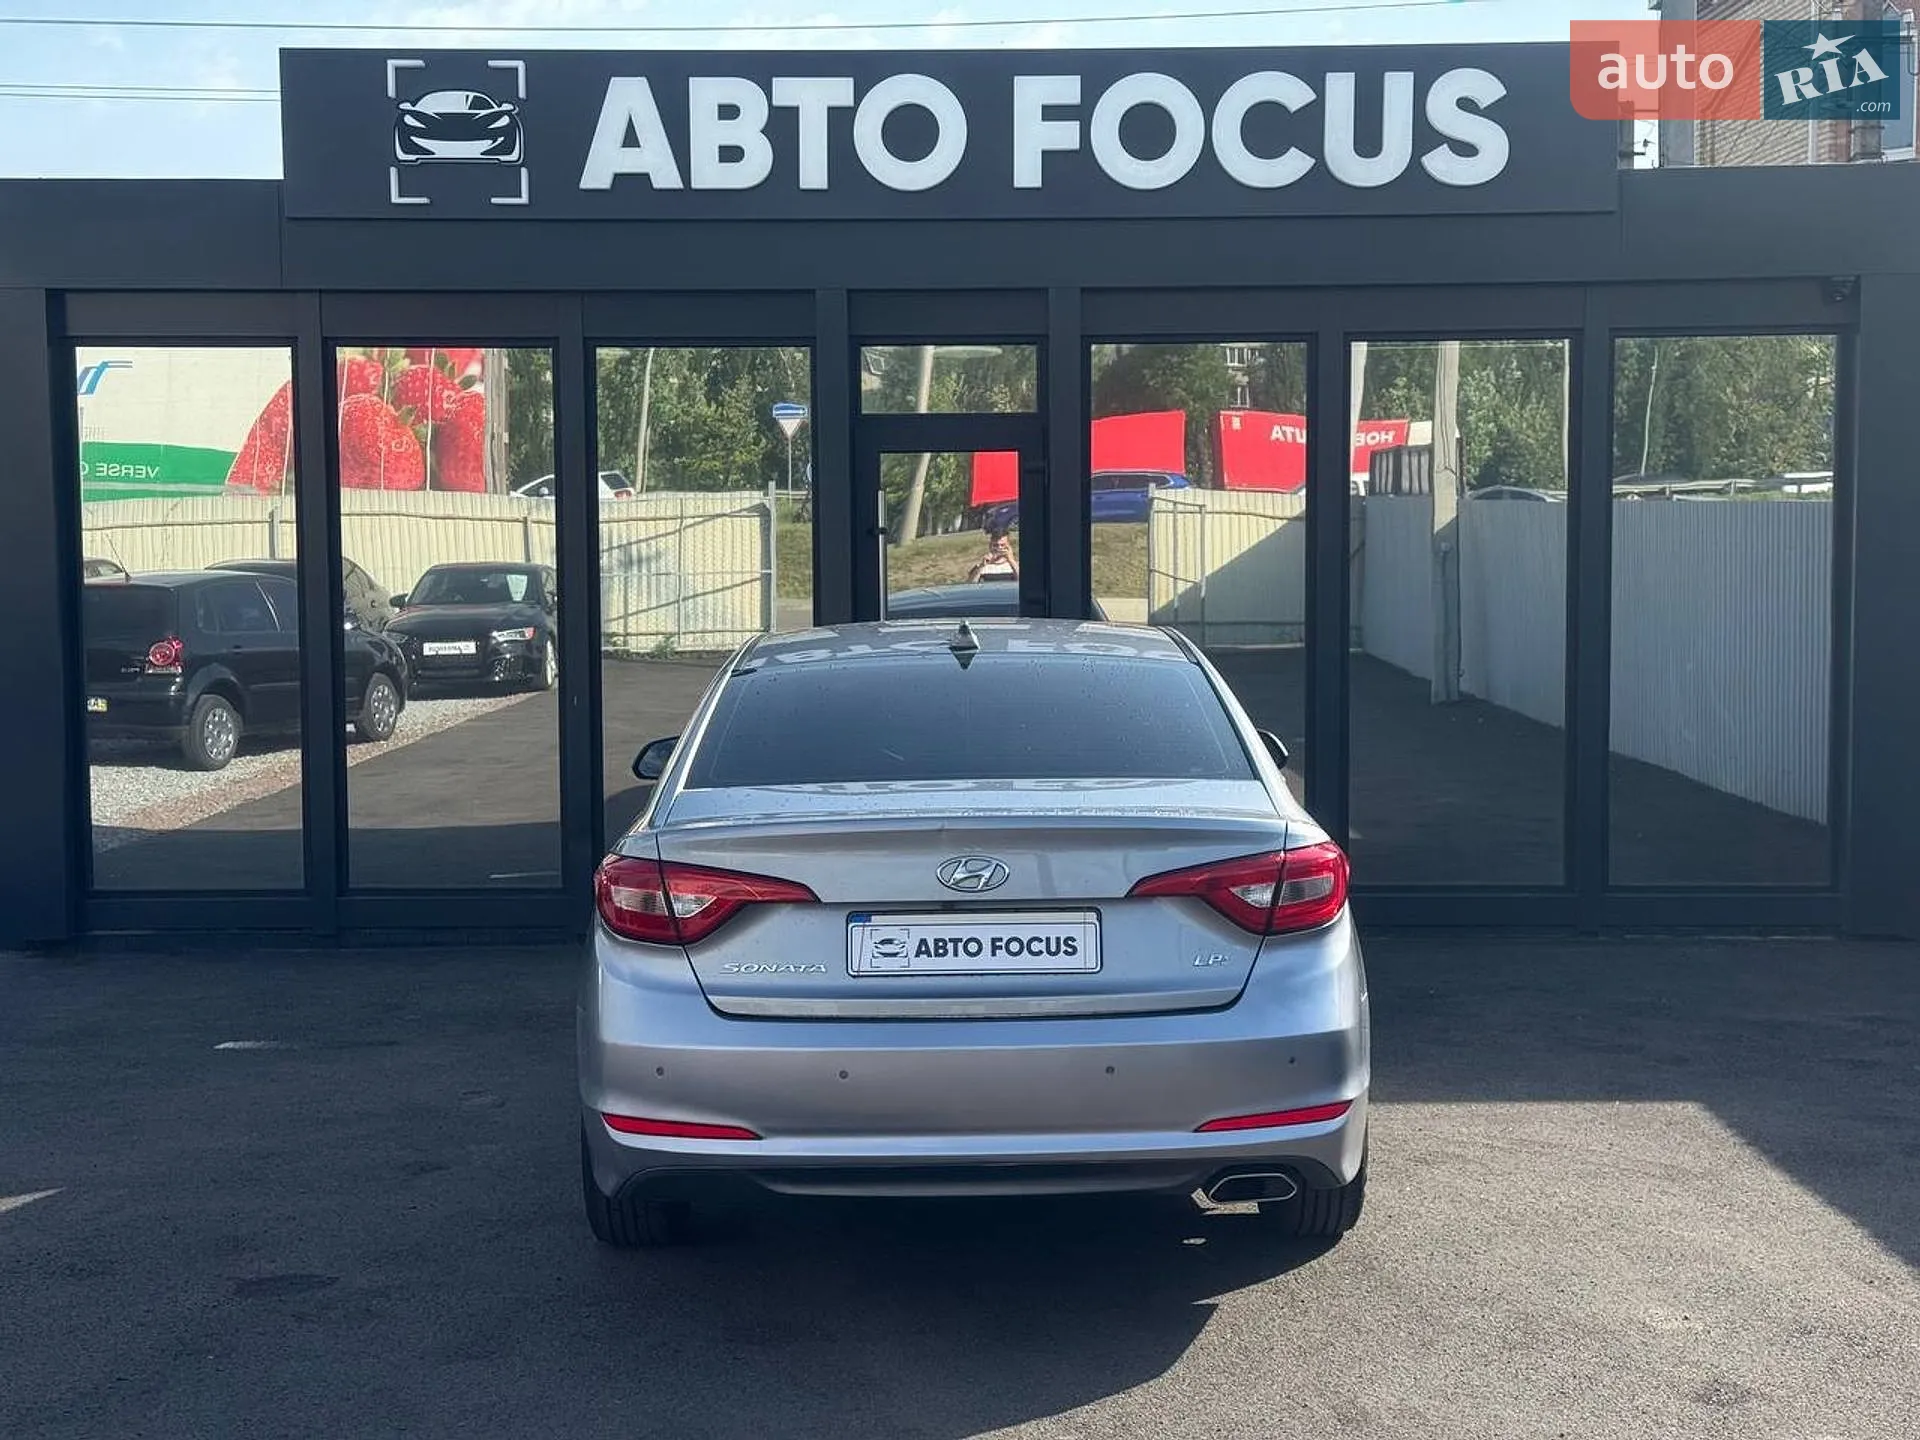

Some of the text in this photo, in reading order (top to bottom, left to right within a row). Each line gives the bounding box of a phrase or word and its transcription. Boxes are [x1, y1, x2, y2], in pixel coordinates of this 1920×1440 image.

[579, 67, 1511, 192] АВТО FOCUS
[914, 935, 1078, 959] АВТО FOCUS
[720, 962, 827, 975] SONATA
